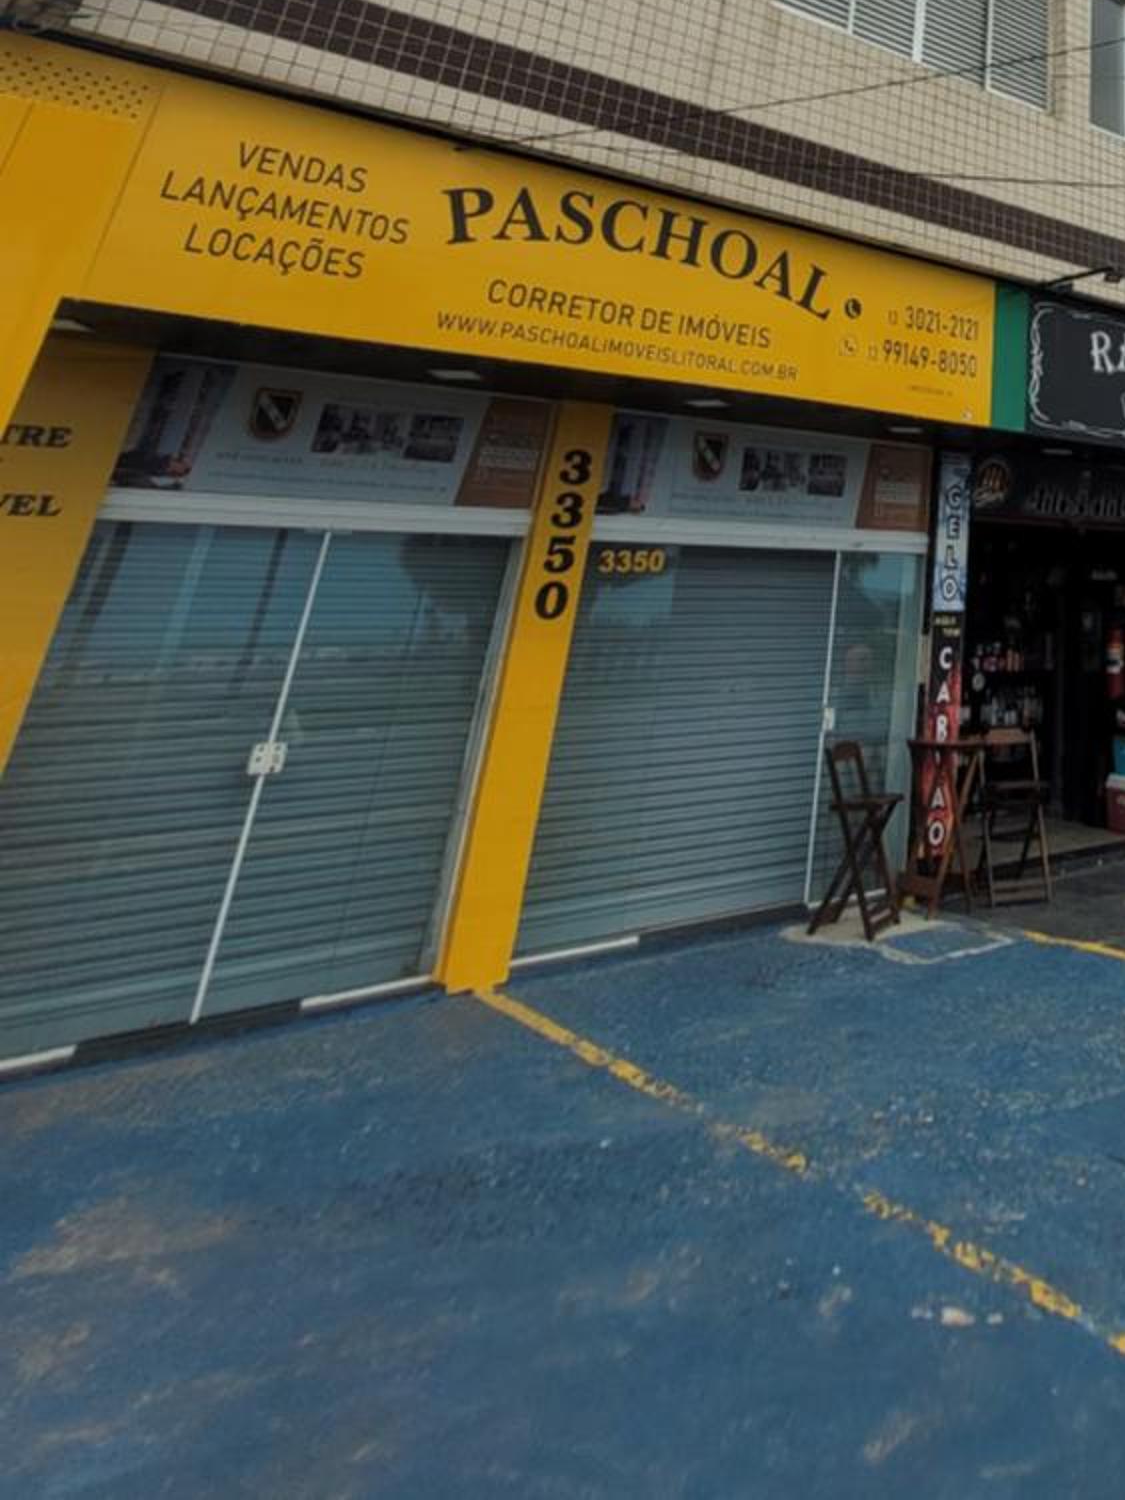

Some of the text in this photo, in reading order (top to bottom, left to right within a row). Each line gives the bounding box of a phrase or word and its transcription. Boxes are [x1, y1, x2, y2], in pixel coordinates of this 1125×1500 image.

[239, 141, 368, 193] VENDAS
[160, 170, 410, 245] LANÇAMENTOS
[184, 222, 366, 279] LOCAÇÕES
[442, 187, 833, 320] PASCHOAL
[437, 311, 799, 381] WWW.PASCHOALIMOVEISLITORAL.COM.BR
[487, 279, 772, 349] CORRETOR DE IMÓVEIS
[905, 305, 979, 341] 3021-2121
[881, 338, 977, 378] 99149-8050
[535, 449, 593, 620] 3350
[598, 549, 667, 573] 3350
[942, 483, 964, 600] GELO
